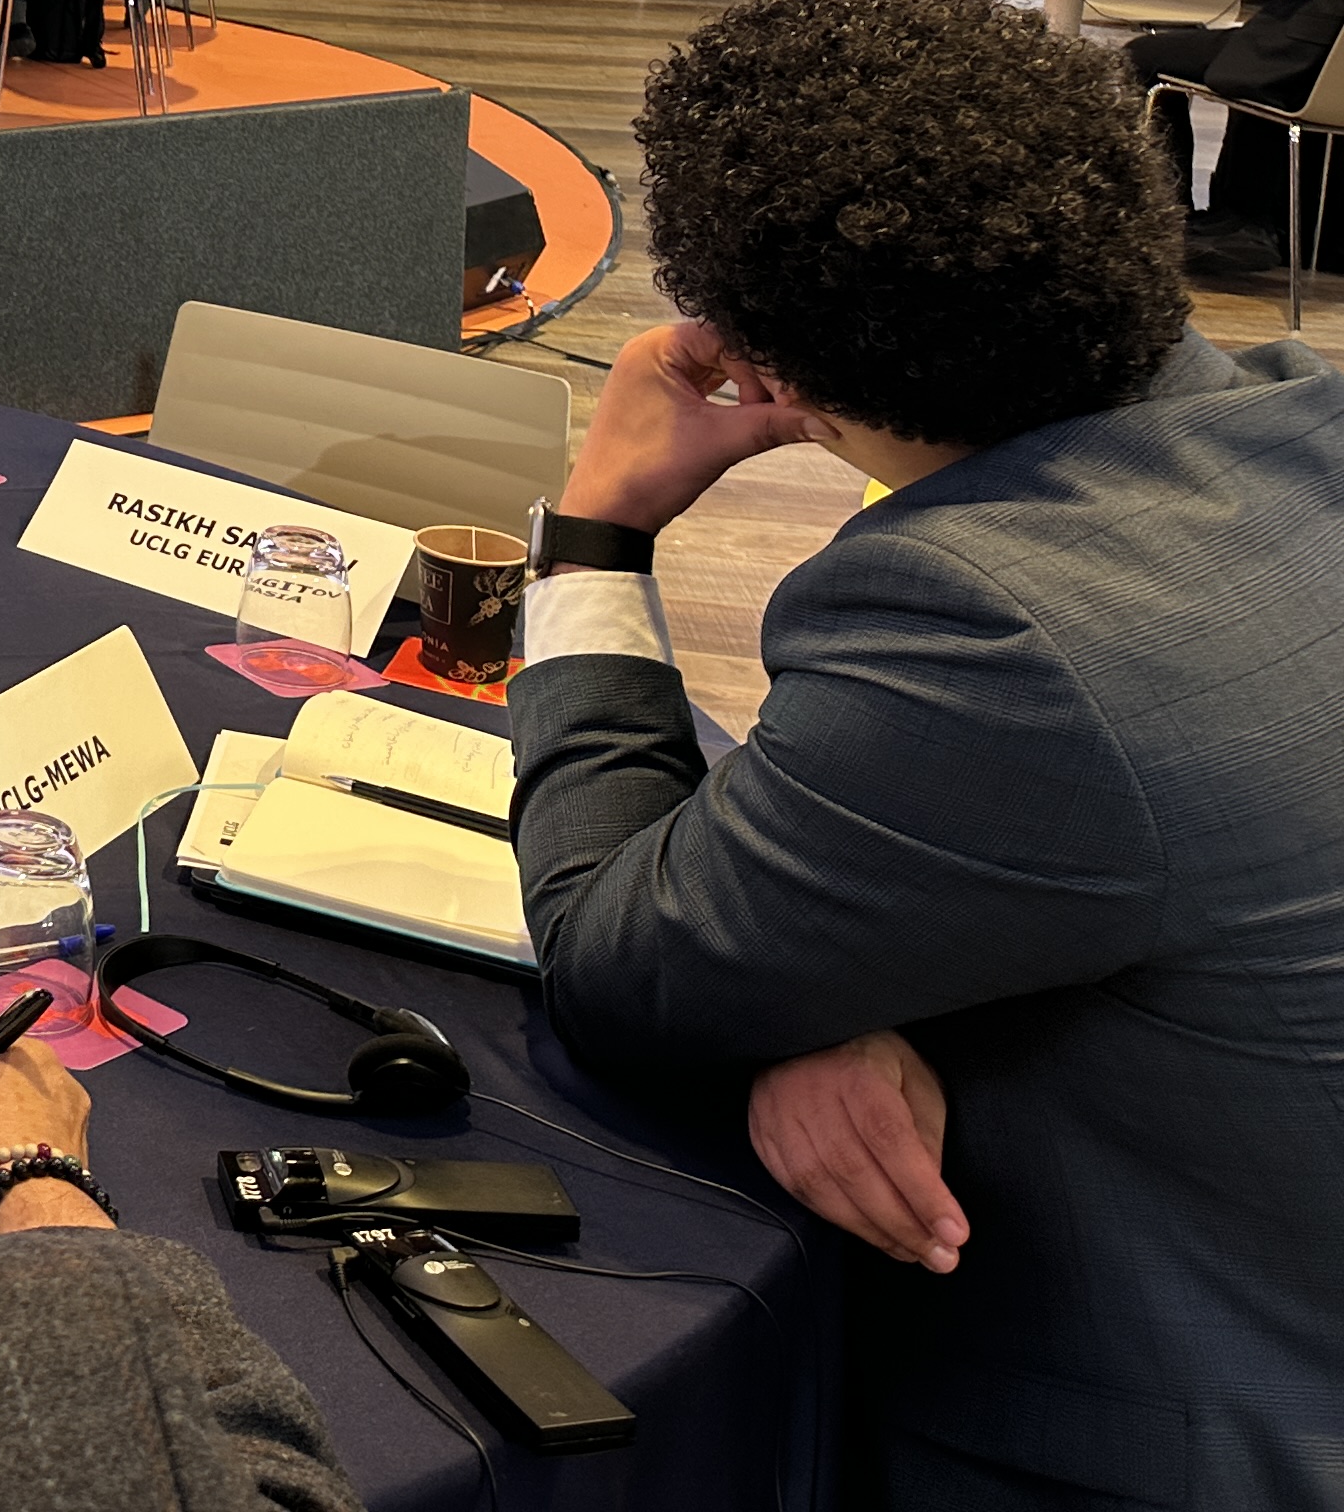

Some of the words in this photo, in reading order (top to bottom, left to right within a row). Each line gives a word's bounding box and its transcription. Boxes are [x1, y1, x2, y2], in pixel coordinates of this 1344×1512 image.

[107, 492, 216, 538] RASIKH
[130, 529, 192, 560] UCLG
[352, 1228, 396, 1243] 1797
